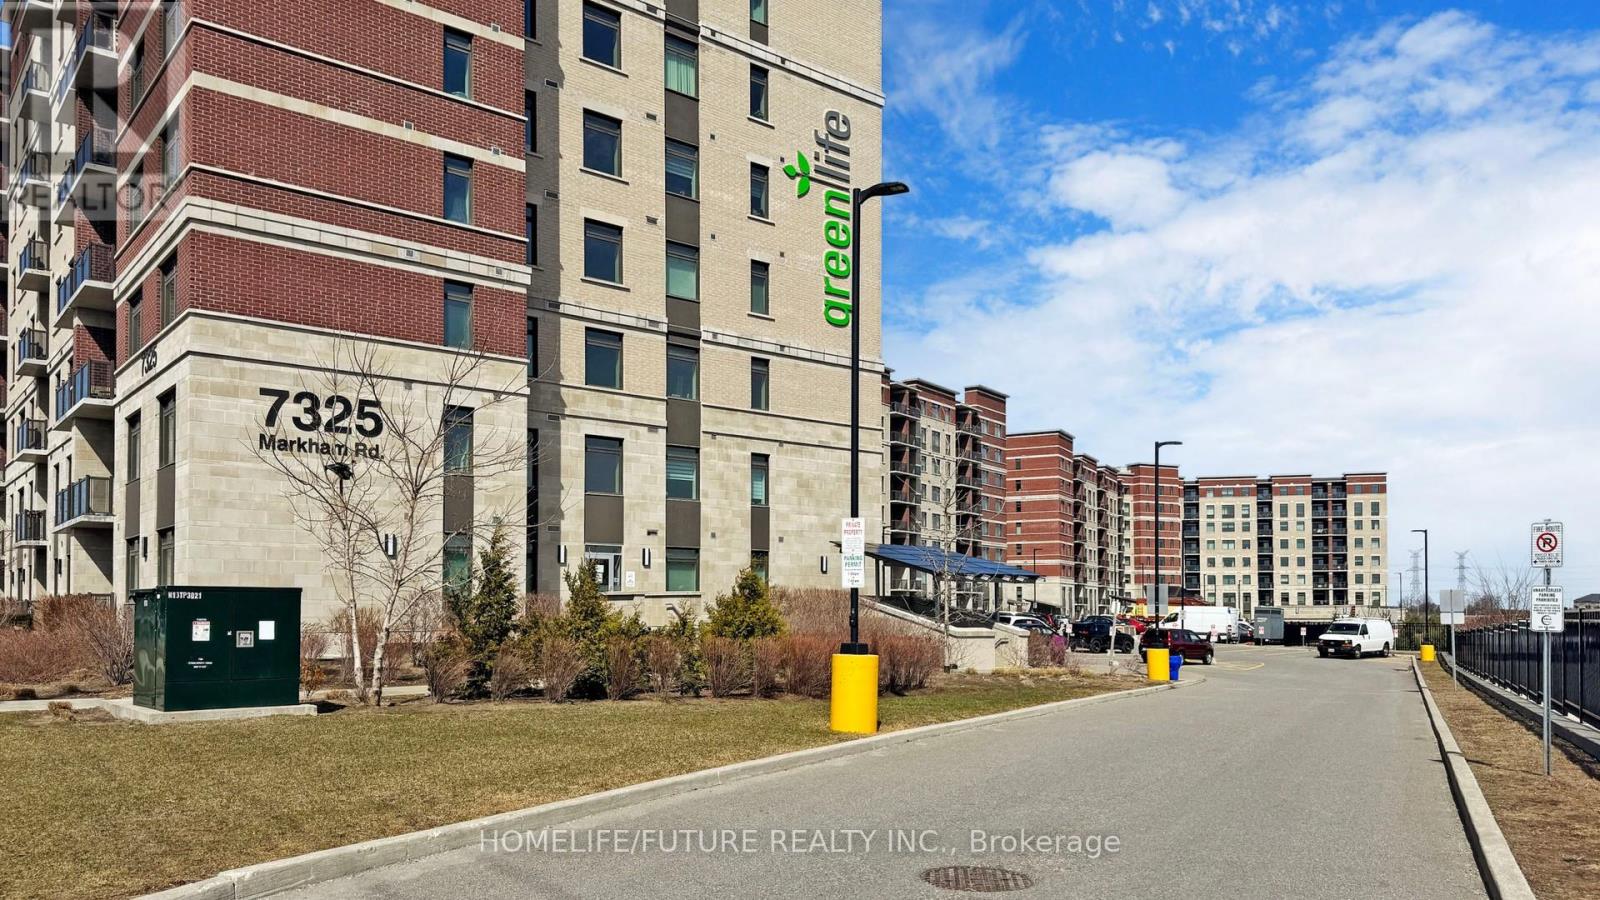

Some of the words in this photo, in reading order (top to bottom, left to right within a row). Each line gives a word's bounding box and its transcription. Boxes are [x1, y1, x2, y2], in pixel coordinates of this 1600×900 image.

[814, 109, 852, 329] greenlife
[259, 387, 384, 438] 7325
[259, 433, 348, 456] Markham
